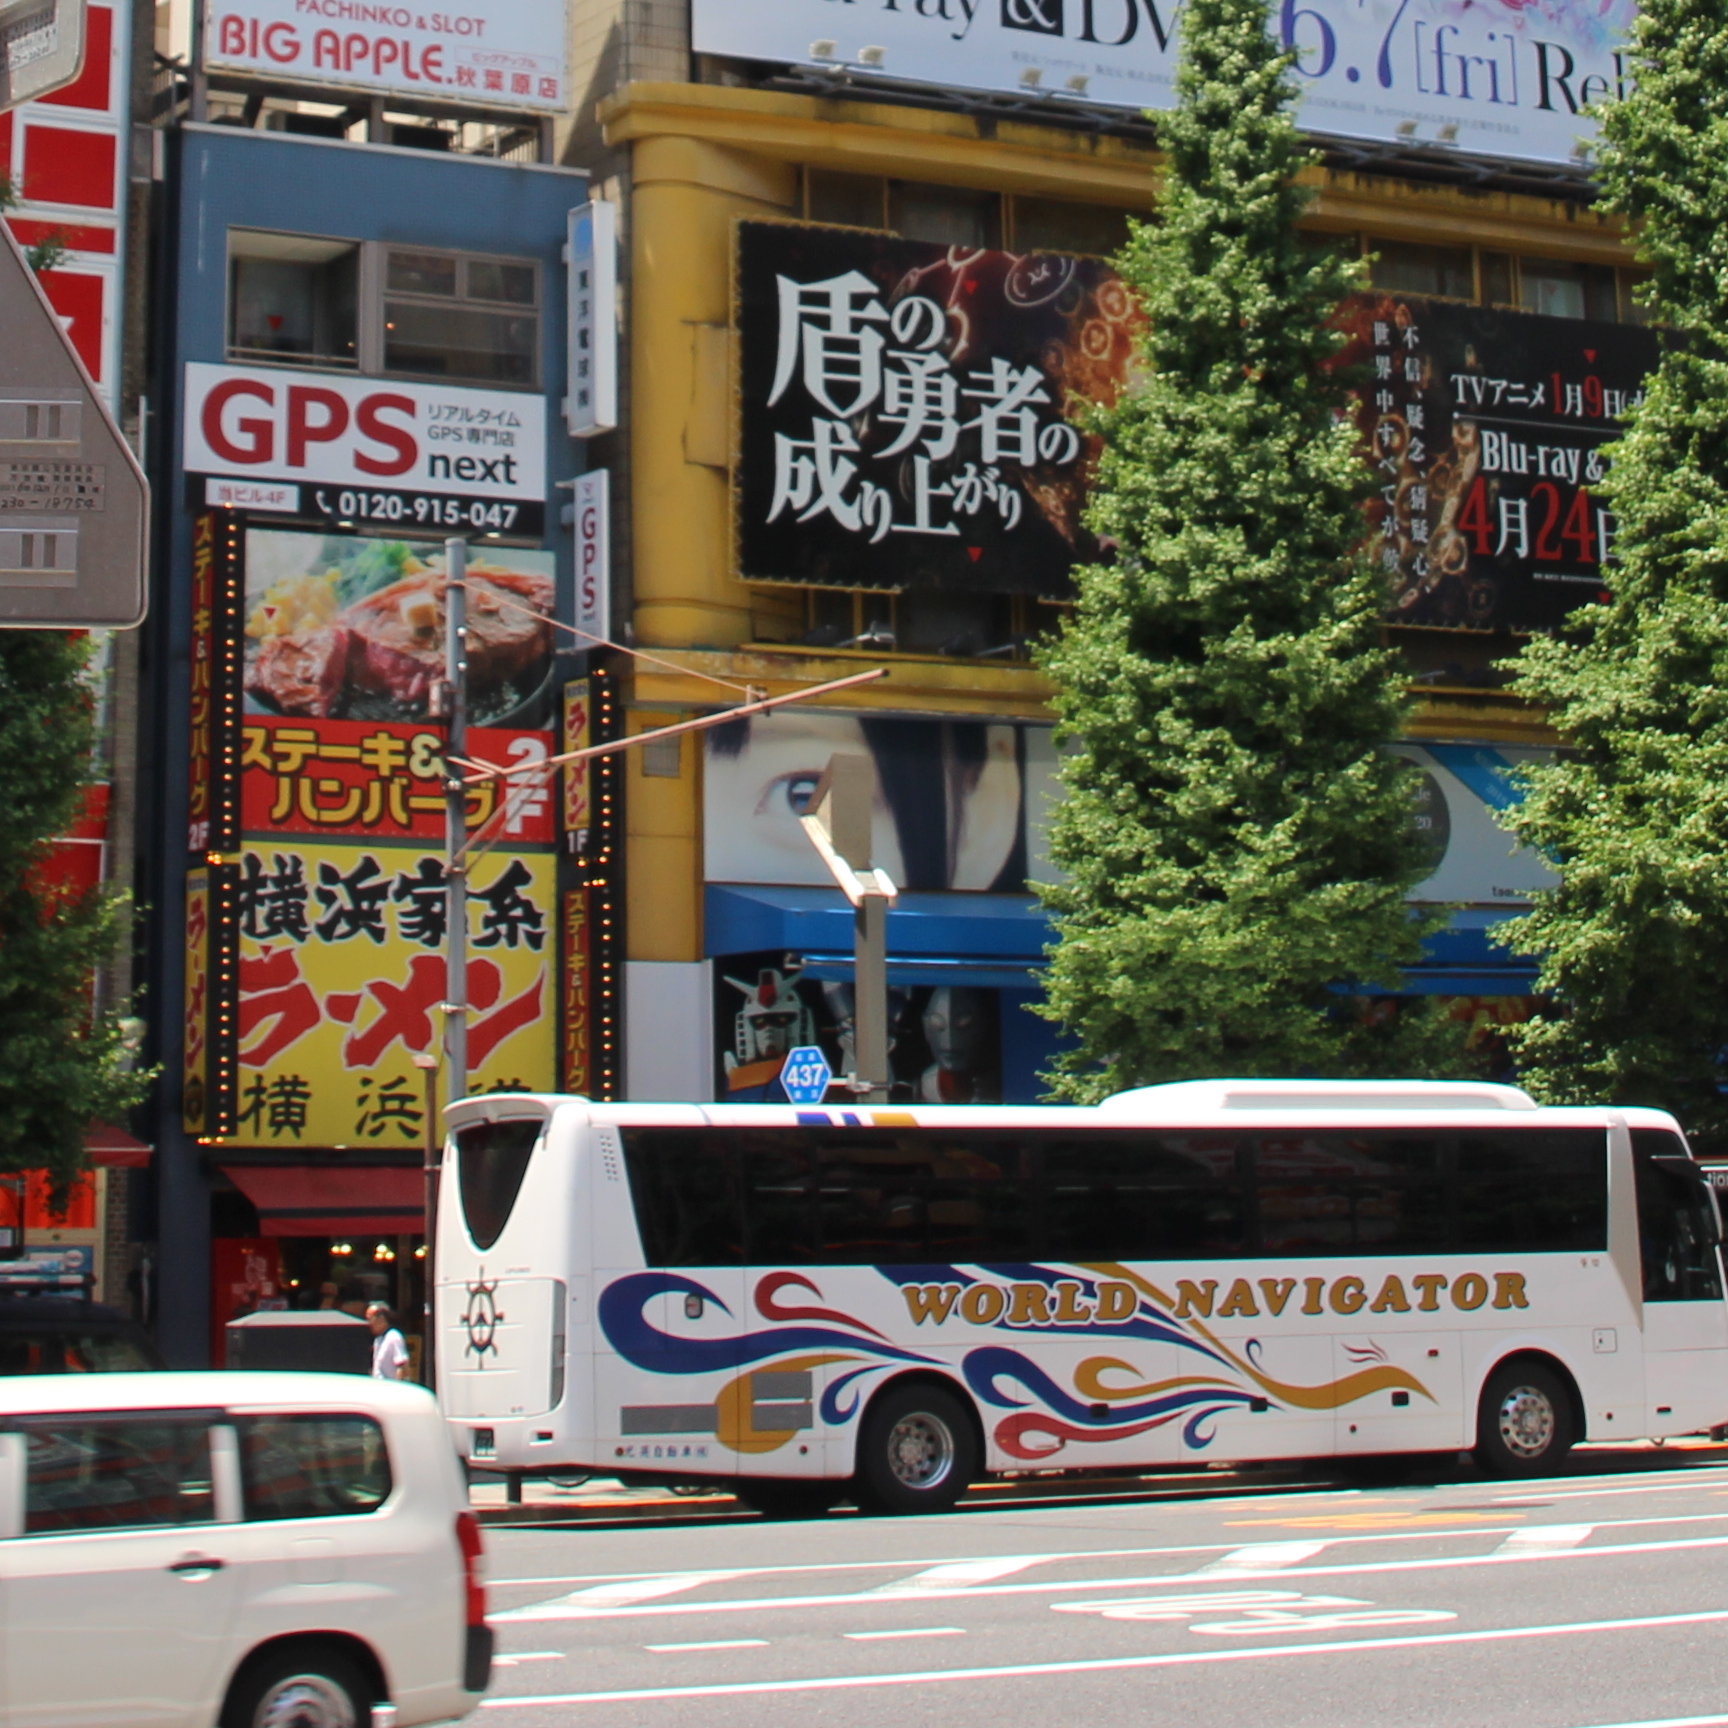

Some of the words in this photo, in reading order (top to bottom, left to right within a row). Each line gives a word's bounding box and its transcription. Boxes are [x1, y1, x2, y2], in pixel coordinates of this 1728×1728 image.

[219, 13, 302, 64] BIG
[416, 15, 427, 30] &
[432, 12, 486, 37] SLOT
[455, 67, 559, 99] 秋葉原店
[1533, 39, 1627, 116] Rel
[201, 377, 419, 479] GPS
[428, 403, 522, 428] リアルタイム
[427, 453, 519, 486] next
[1481, 430, 1582, 484] Blu-ray
[338, 491, 519, 529] 0120-915-047
[581, 506, 597, 610] GPS
[272, 776, 497, 830] ハンバーグ
[238, 851, 550, 954] 横浜家系
[786, 1062, 825, 1088] 437
[900, 1279, 1140, 1328] WORLD
[1173, 1272, 1530, 1321] NAVIGATOR
